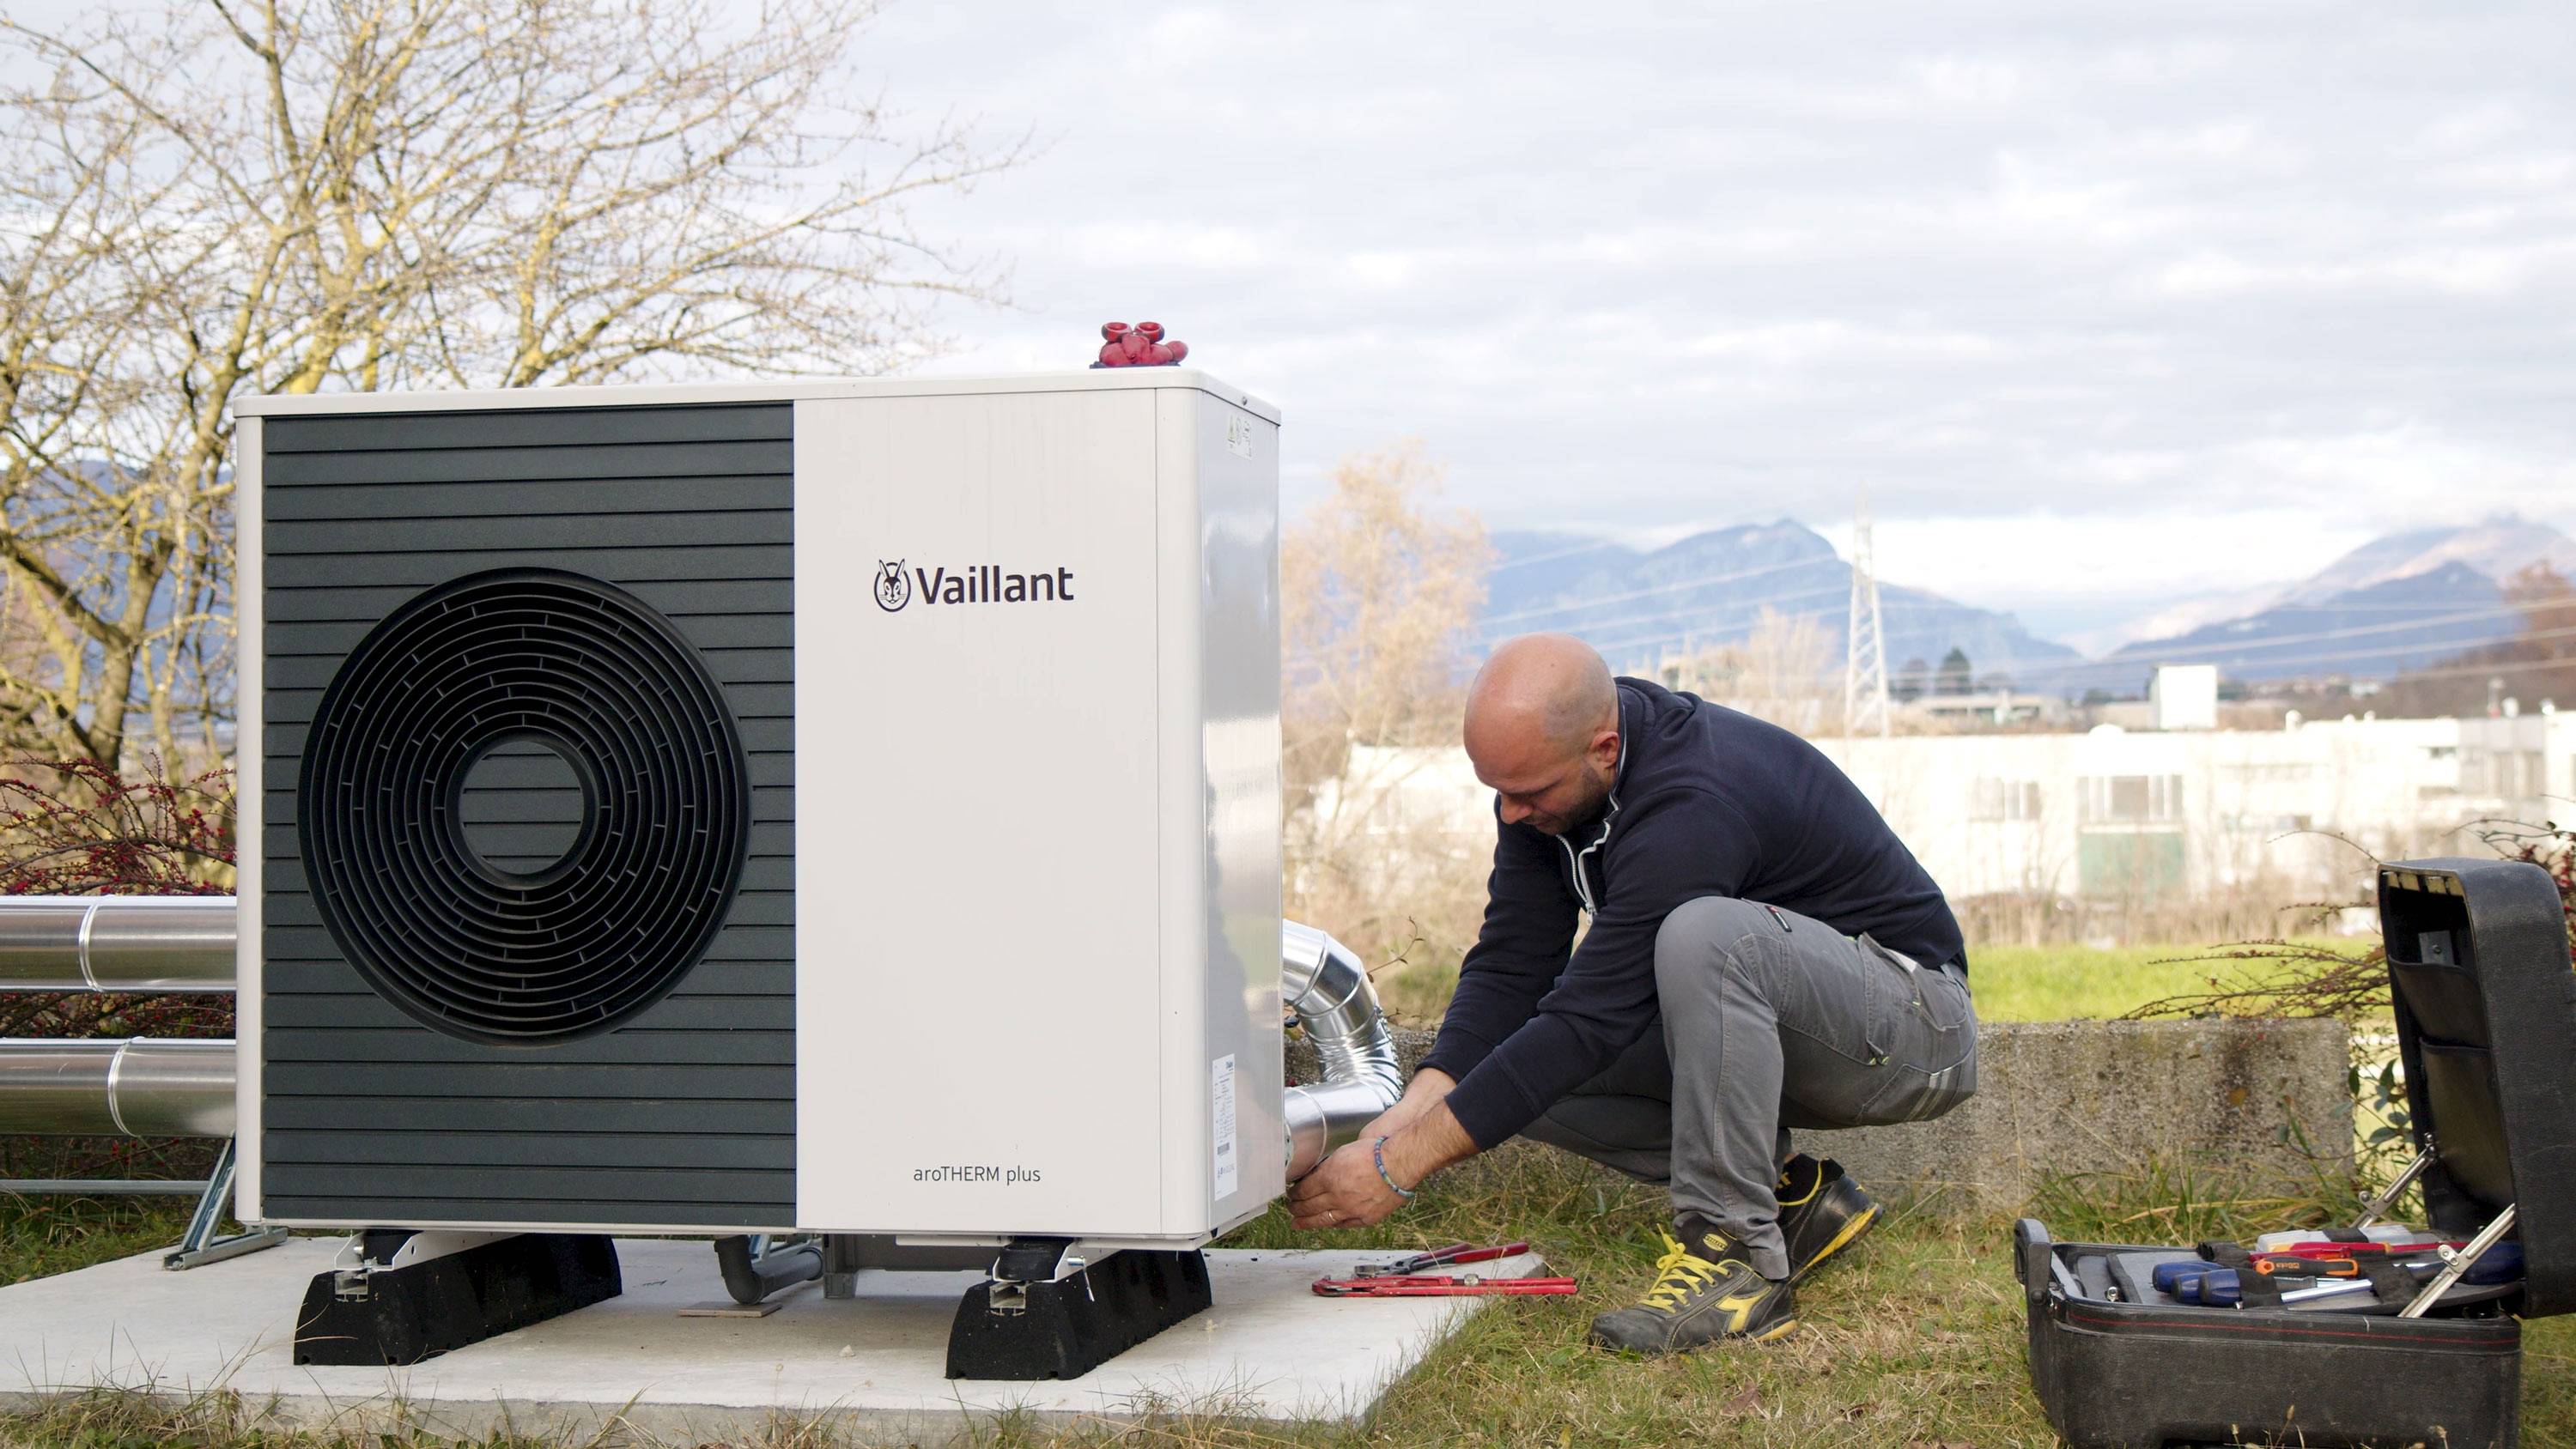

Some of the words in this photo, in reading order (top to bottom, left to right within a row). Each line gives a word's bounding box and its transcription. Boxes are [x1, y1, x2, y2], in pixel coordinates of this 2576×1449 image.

[915, 565, 1074, 604] Vaillant
[913, 1165, 999, 1182] aroTHERM
[1006, 1165, 1041, 1186] plus
